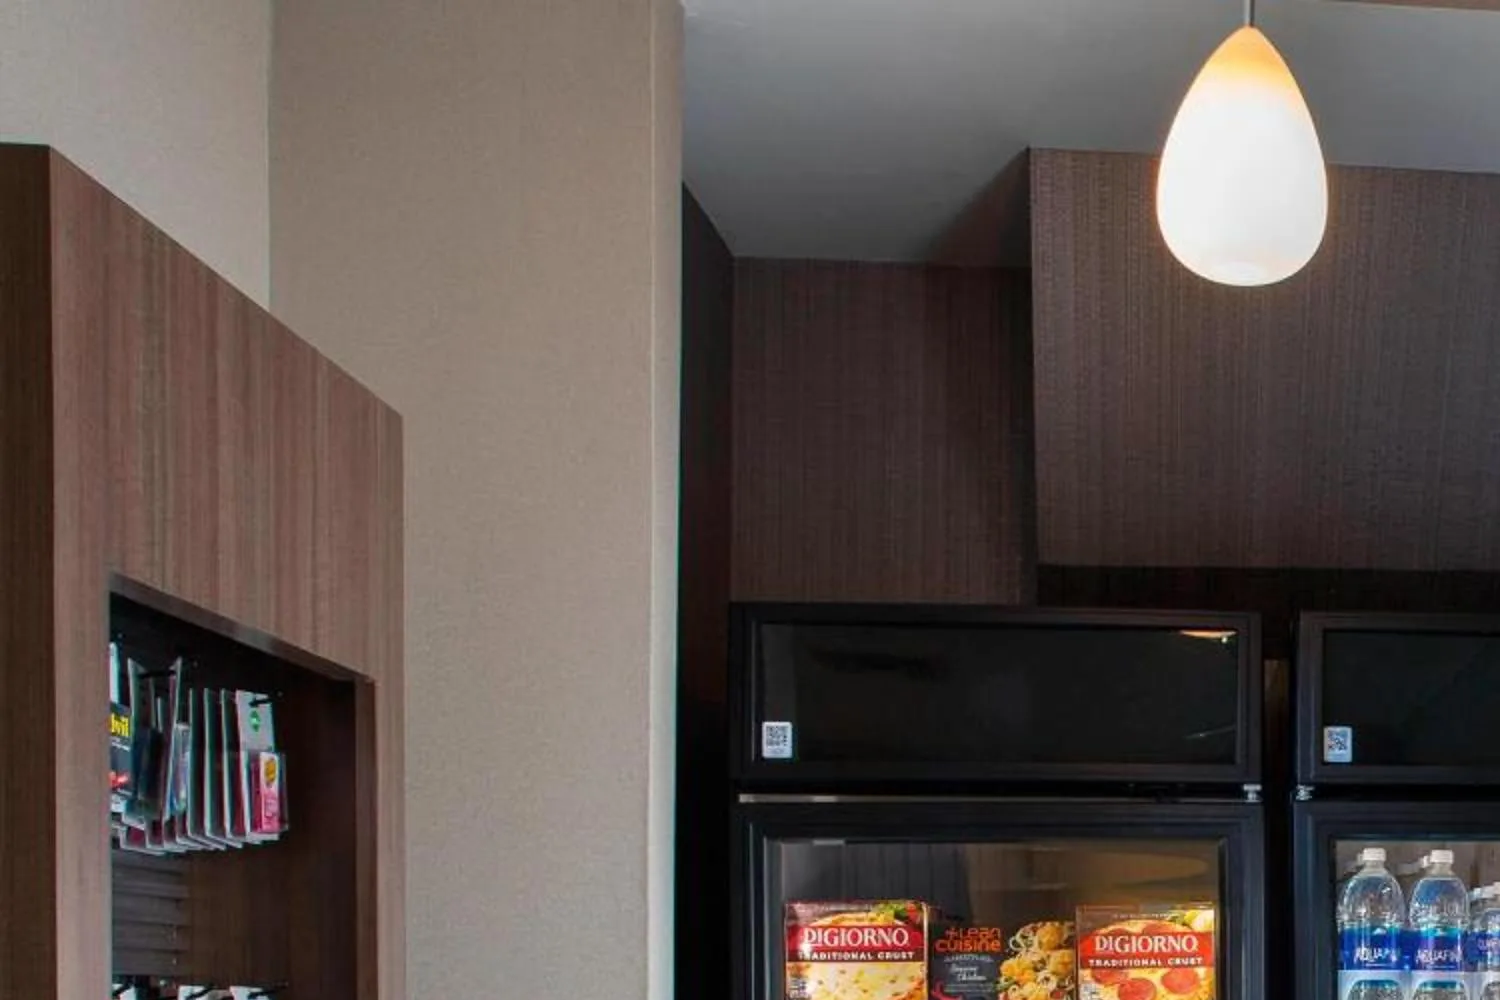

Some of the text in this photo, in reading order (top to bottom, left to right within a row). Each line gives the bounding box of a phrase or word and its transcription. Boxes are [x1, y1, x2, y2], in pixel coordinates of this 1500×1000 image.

[803, 927, 909, 947] DIGIORNO
[1095, 935, 1199, 953] DIGIORNO
[934, 938, 1001, 952] cuisine
[877, 951, 916, 960] CRUST
[1088, 957, 1203, 967] TRADITIONAL CRUST
